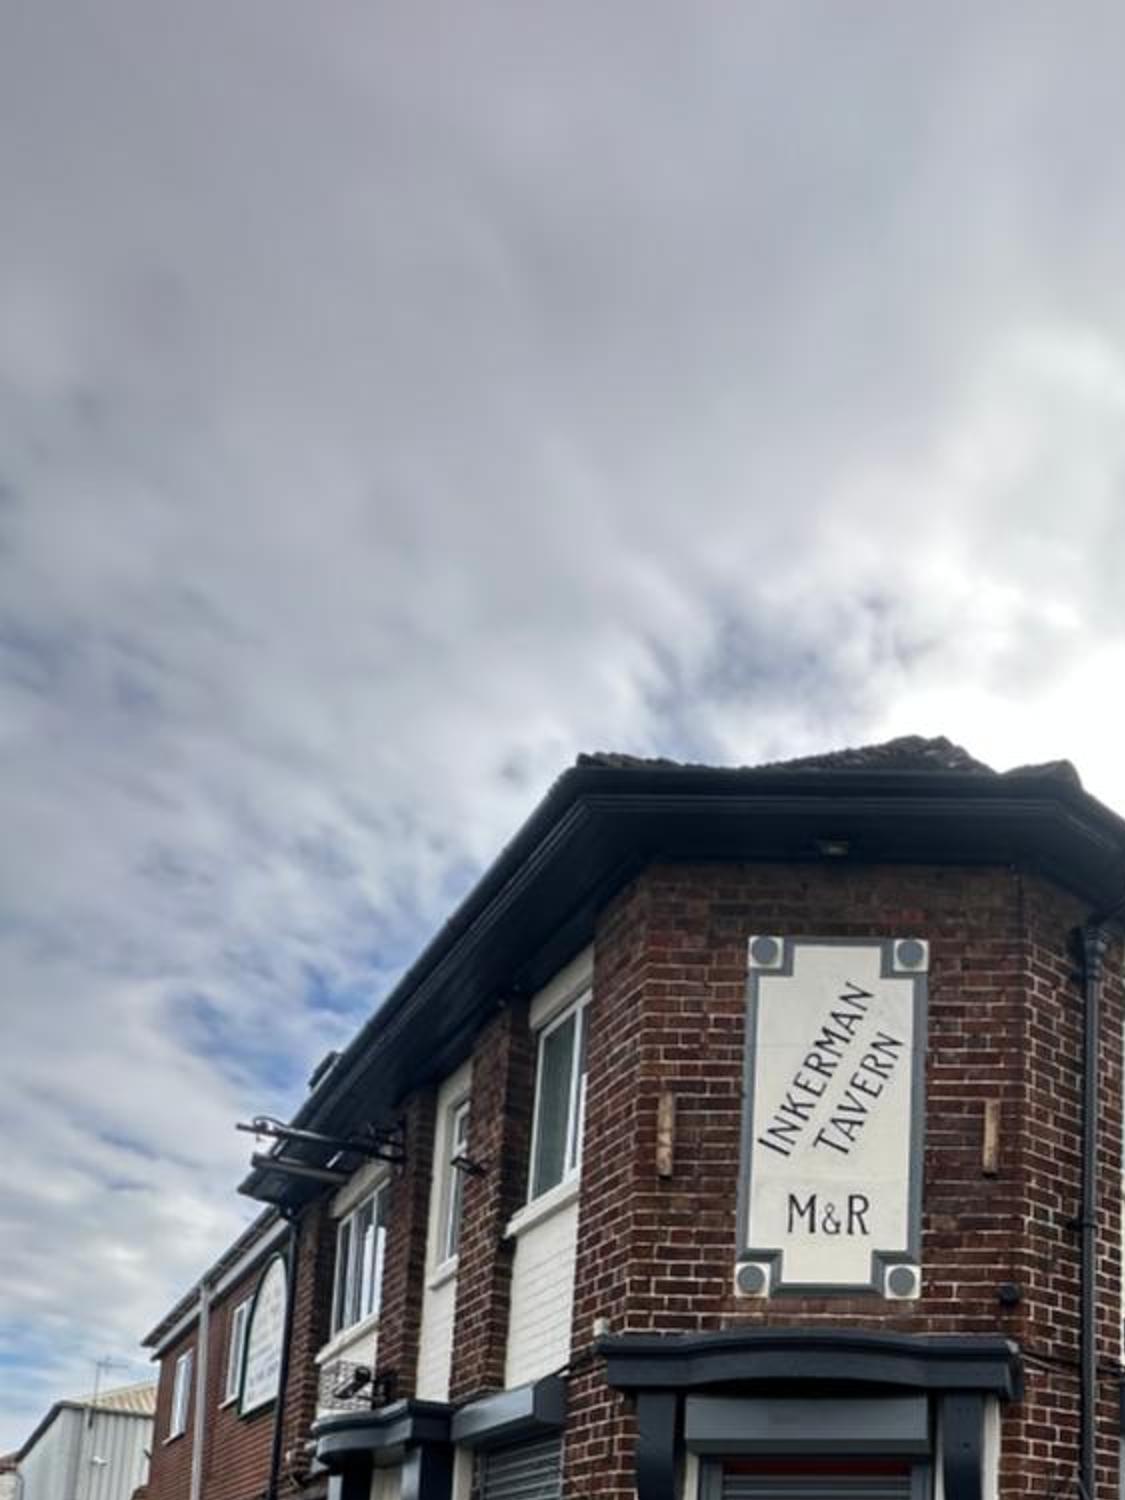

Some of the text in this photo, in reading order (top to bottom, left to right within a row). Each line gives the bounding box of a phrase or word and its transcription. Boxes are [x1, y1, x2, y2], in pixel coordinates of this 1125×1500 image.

[758, 981, 874, 1156] INKERMAN
[813, 1032, 904, 1155] TAVERN
[787, 1194, 870, 1236] M&R
